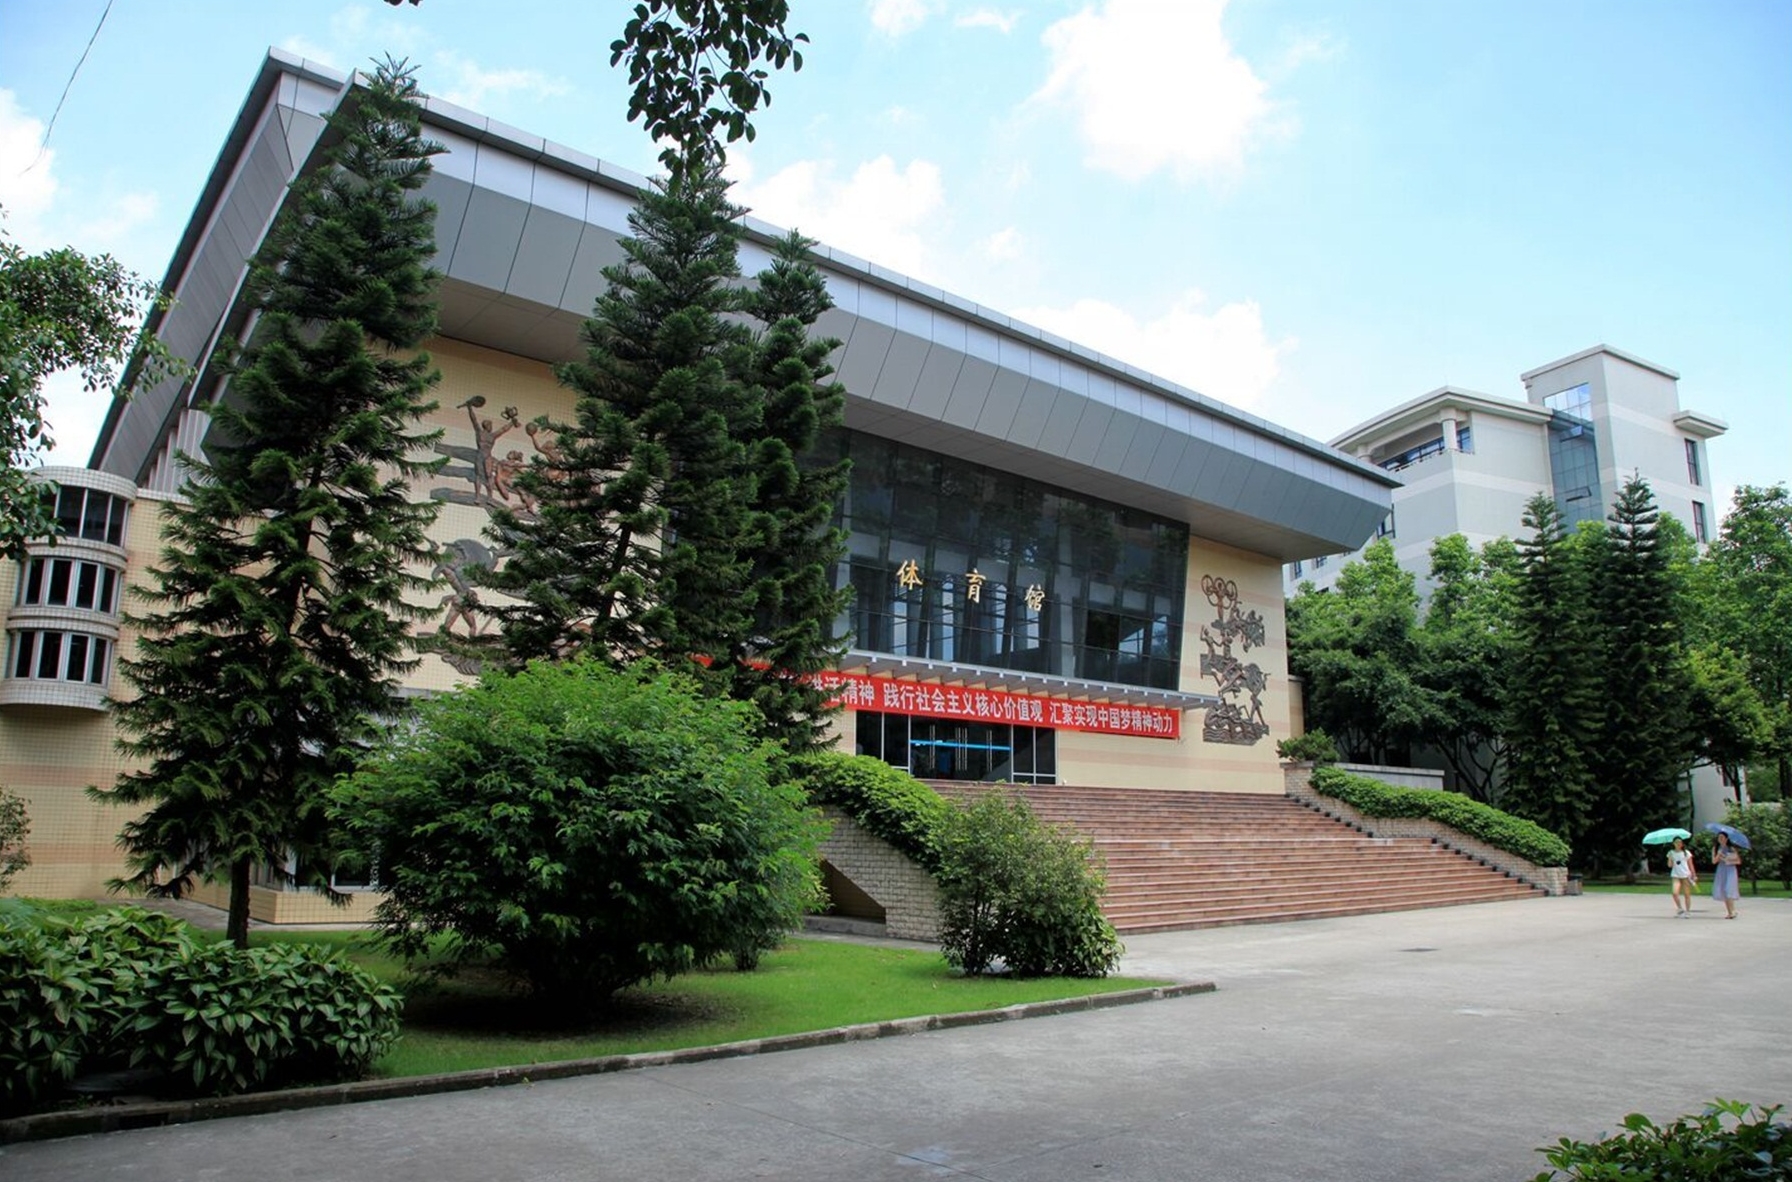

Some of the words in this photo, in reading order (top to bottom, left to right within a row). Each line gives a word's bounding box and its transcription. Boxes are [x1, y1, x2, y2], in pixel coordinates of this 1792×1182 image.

[896, 558, 1045, 612] 体育馆
[883, 682, 1044, 722] 践行社会主义核心价值观
[1050, 701, 1173, 734] 汇聚实现中国梦精神动力
